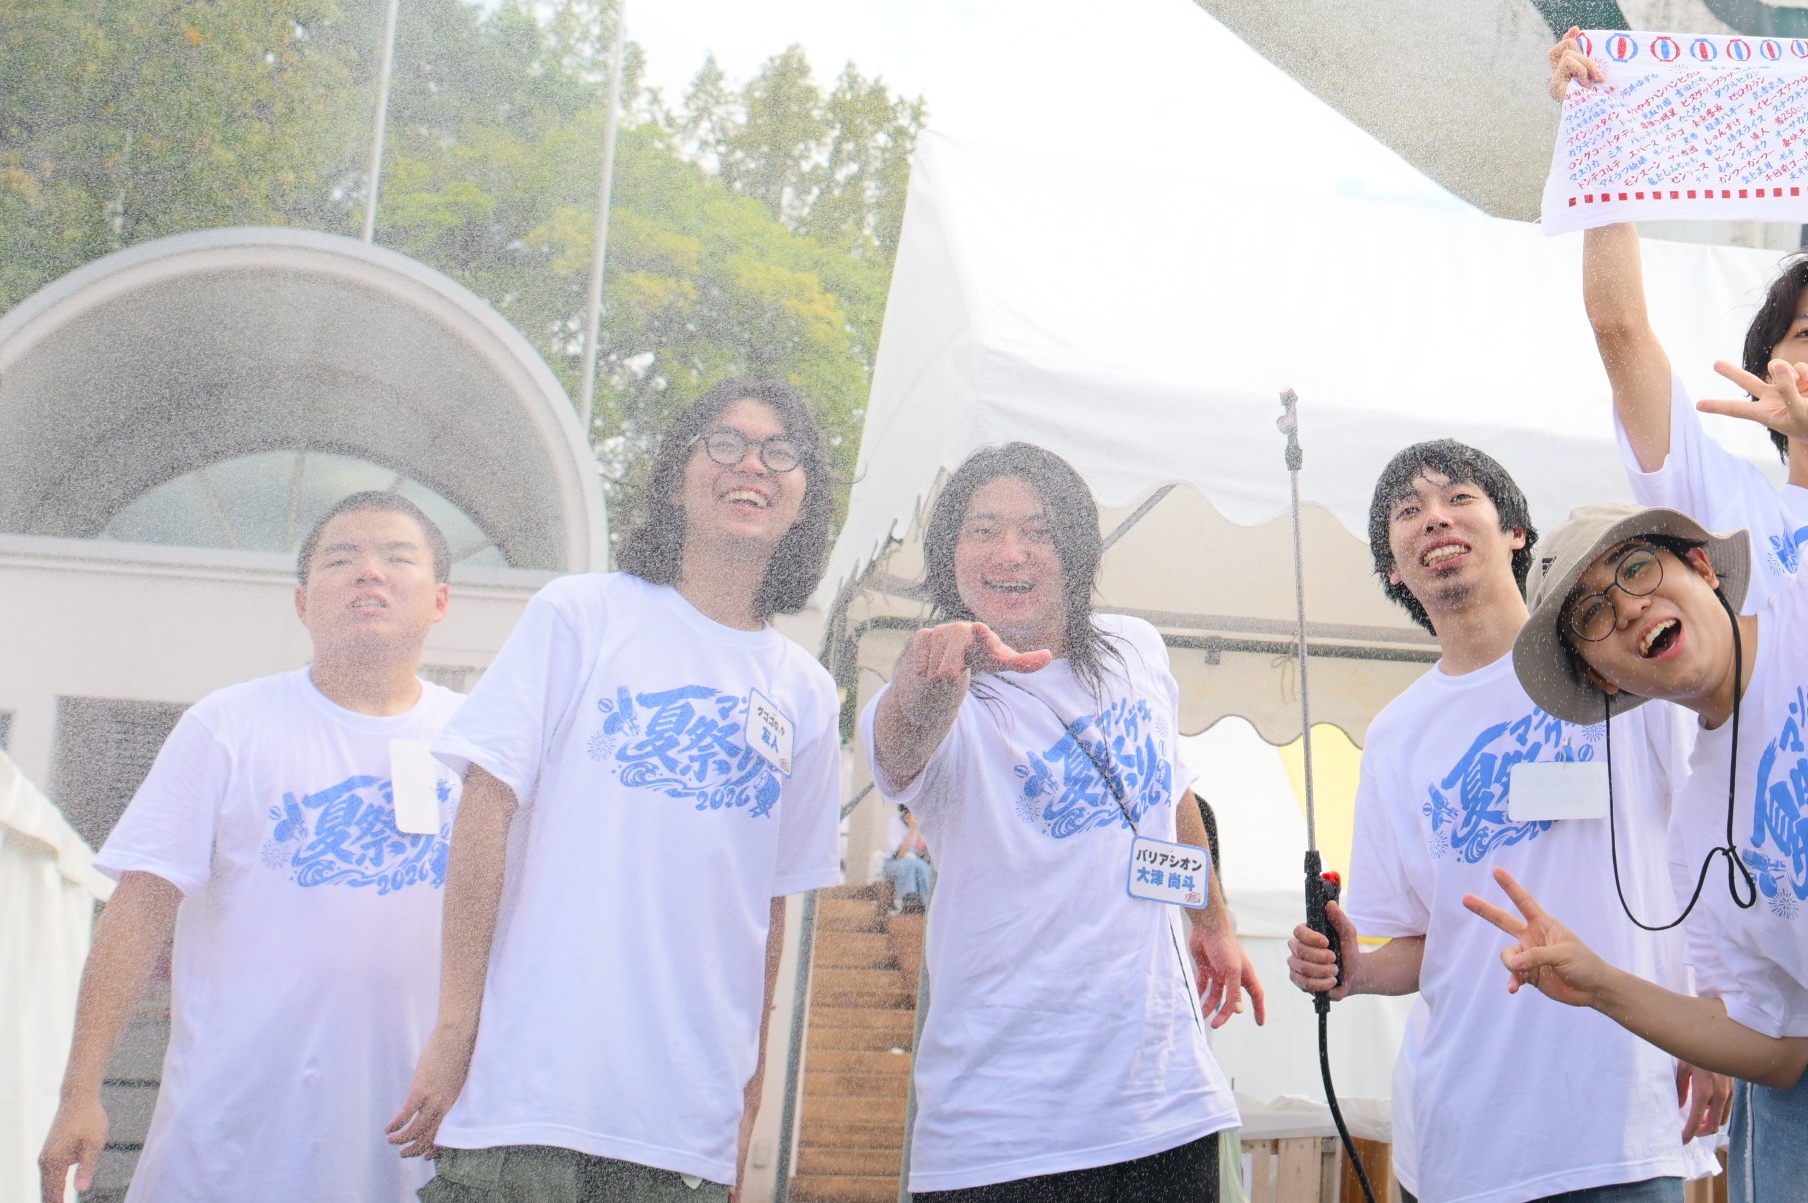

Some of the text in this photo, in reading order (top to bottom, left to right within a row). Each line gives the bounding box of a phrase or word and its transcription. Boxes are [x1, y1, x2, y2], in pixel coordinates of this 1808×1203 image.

[1570, 159, 1600, 181] マユリカ
[1608, 145, 1623, 159] ミキ
[695, 786, 750, 811] 2026
[1136, 849, 1203, 872] バリアシオン
[377, 860, 428, 896] 2026
